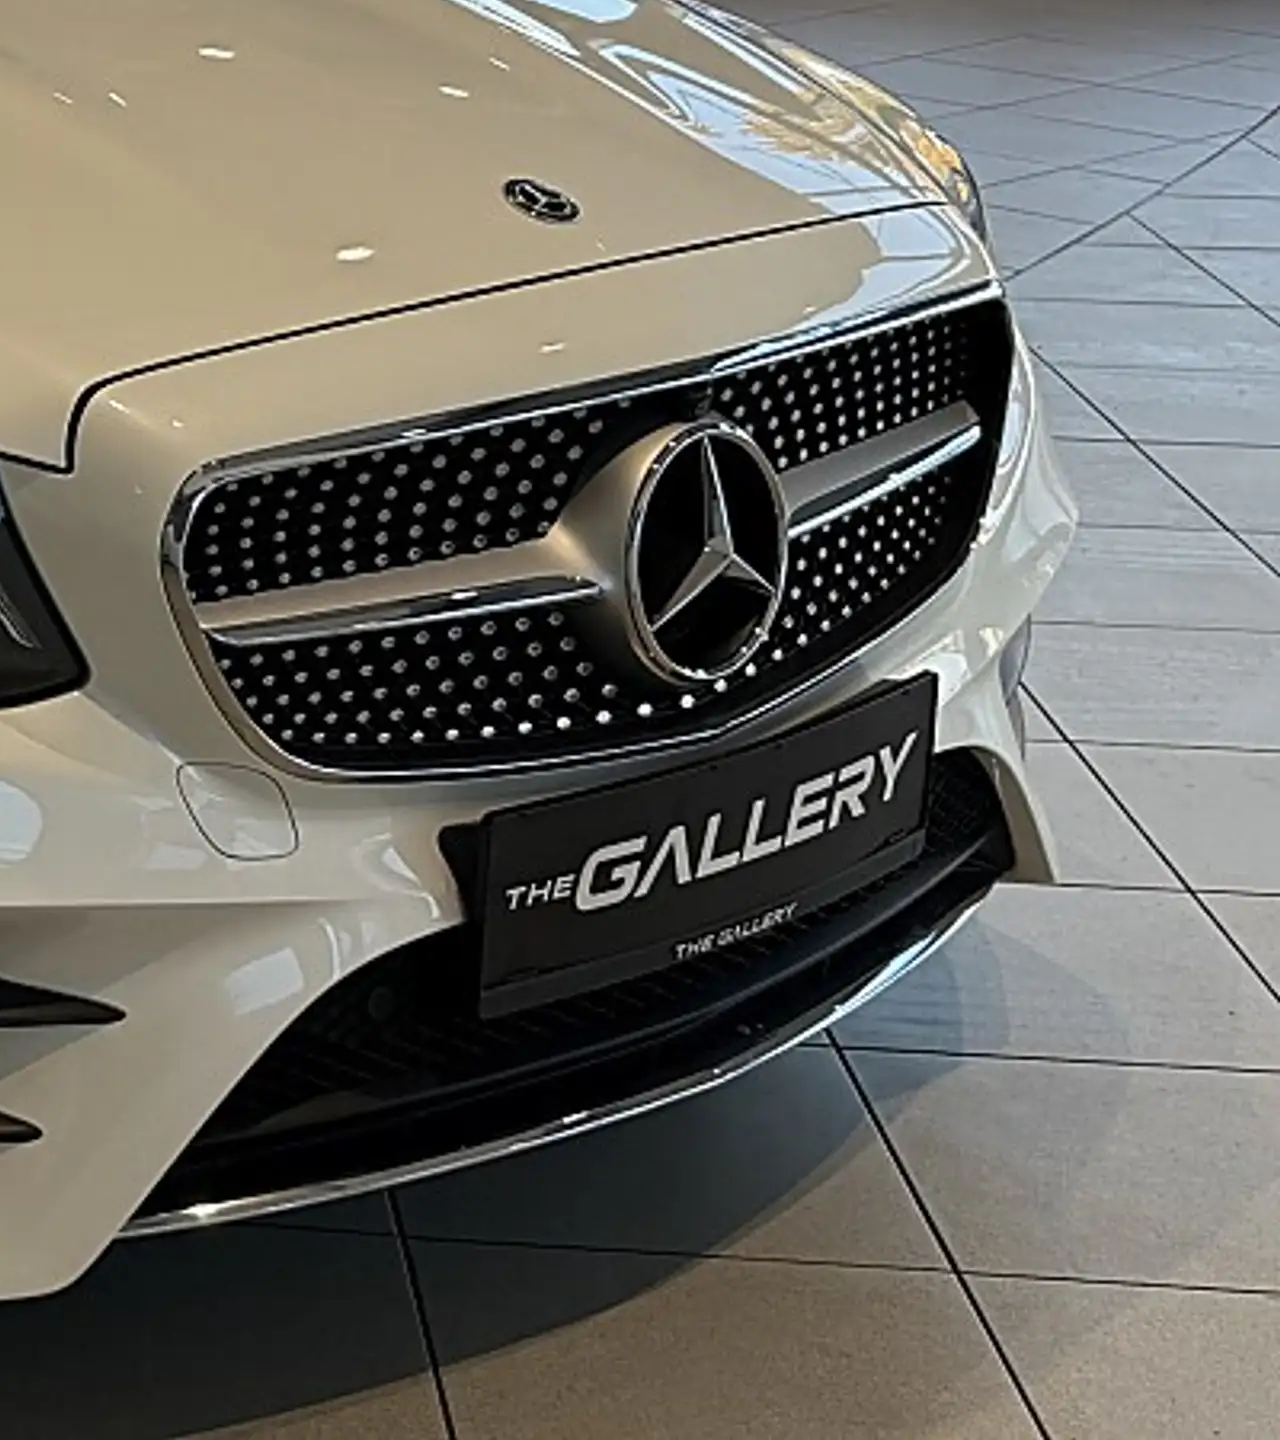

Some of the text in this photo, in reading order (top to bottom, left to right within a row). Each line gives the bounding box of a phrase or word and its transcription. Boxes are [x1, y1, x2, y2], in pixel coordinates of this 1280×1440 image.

[505, 731, 919, 912] THE GALLERY
[674, 902, 798, 960] THE GALLERY
